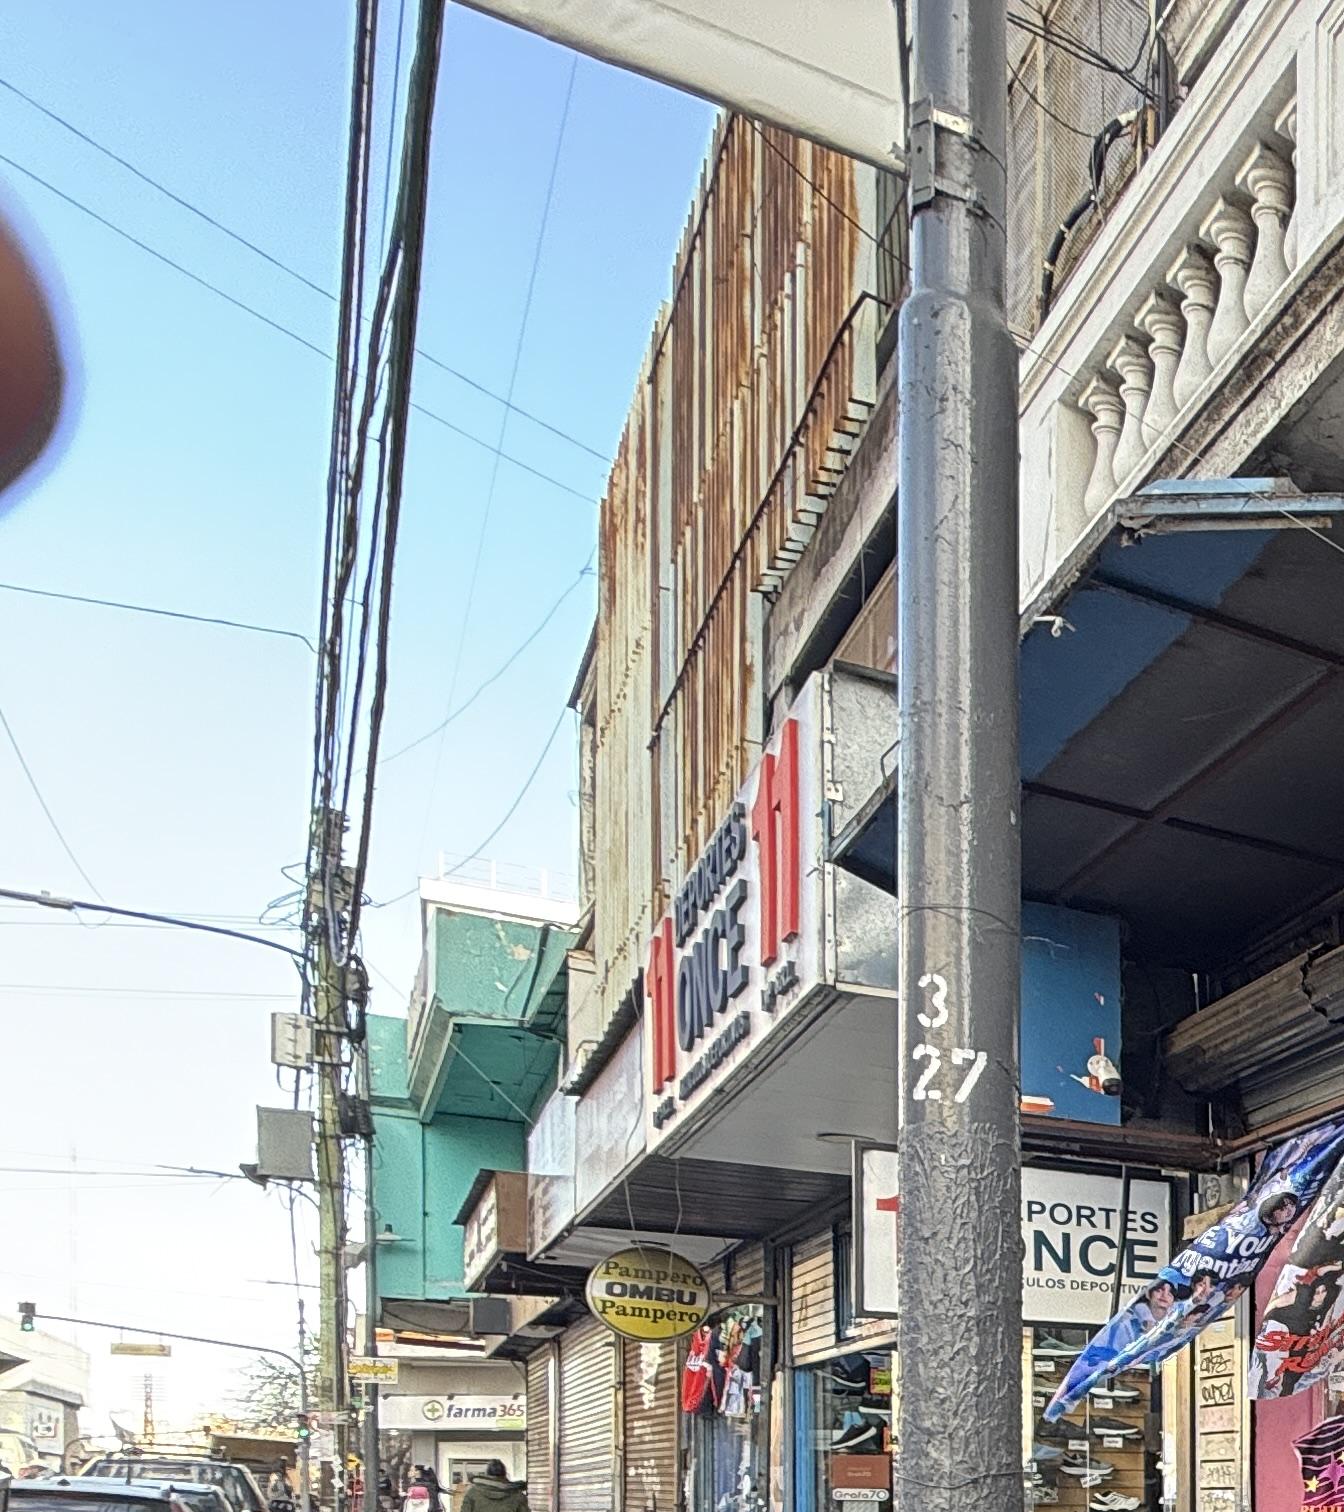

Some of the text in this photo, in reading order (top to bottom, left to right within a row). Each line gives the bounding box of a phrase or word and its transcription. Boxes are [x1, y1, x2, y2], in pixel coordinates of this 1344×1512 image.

[674, 801, 748, 948] DEPORTES
[678, 878, 750, 1052] ONCE
[917, 973, 949, 1028] 3
[912, 1043, 988, 1104] 27
[1027, 1200, 1159, 1234] PORTES
[602, 1261, 705, 1287] Pampero
[1033, 1229, 1159, 1280] NCE
[599, 1299, 702, 1323] Pampero
[605, 1281, 697, 1305] OMBU
[446, 1403, 525, 1418] farma365
